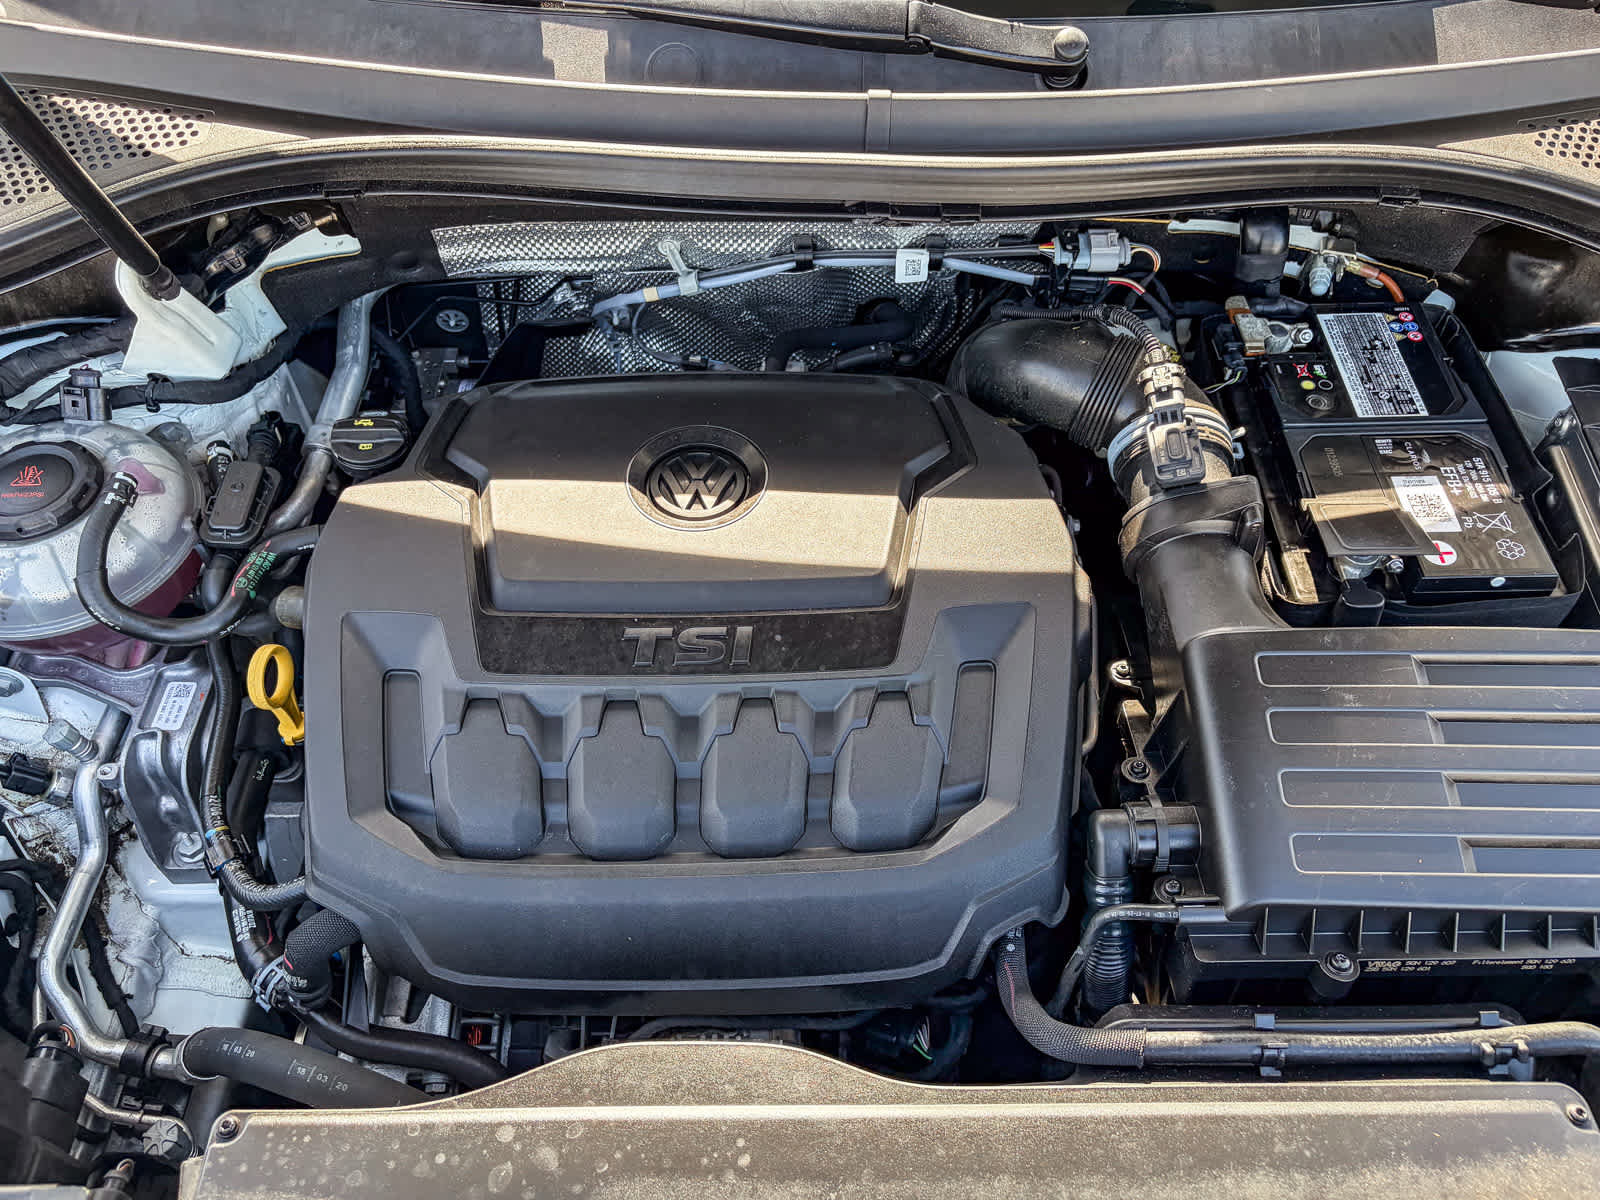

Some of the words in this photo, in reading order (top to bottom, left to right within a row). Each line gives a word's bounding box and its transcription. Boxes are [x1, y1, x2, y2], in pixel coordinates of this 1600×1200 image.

[1404, 441, 1421, 470] CLARIOS
[1440, 466, 1464, 497] EFB+
[1479, 470, 1493, 483] 915
[1461, 516, 1475, 529] Pb
[623, 626, 753, 667] TSI
